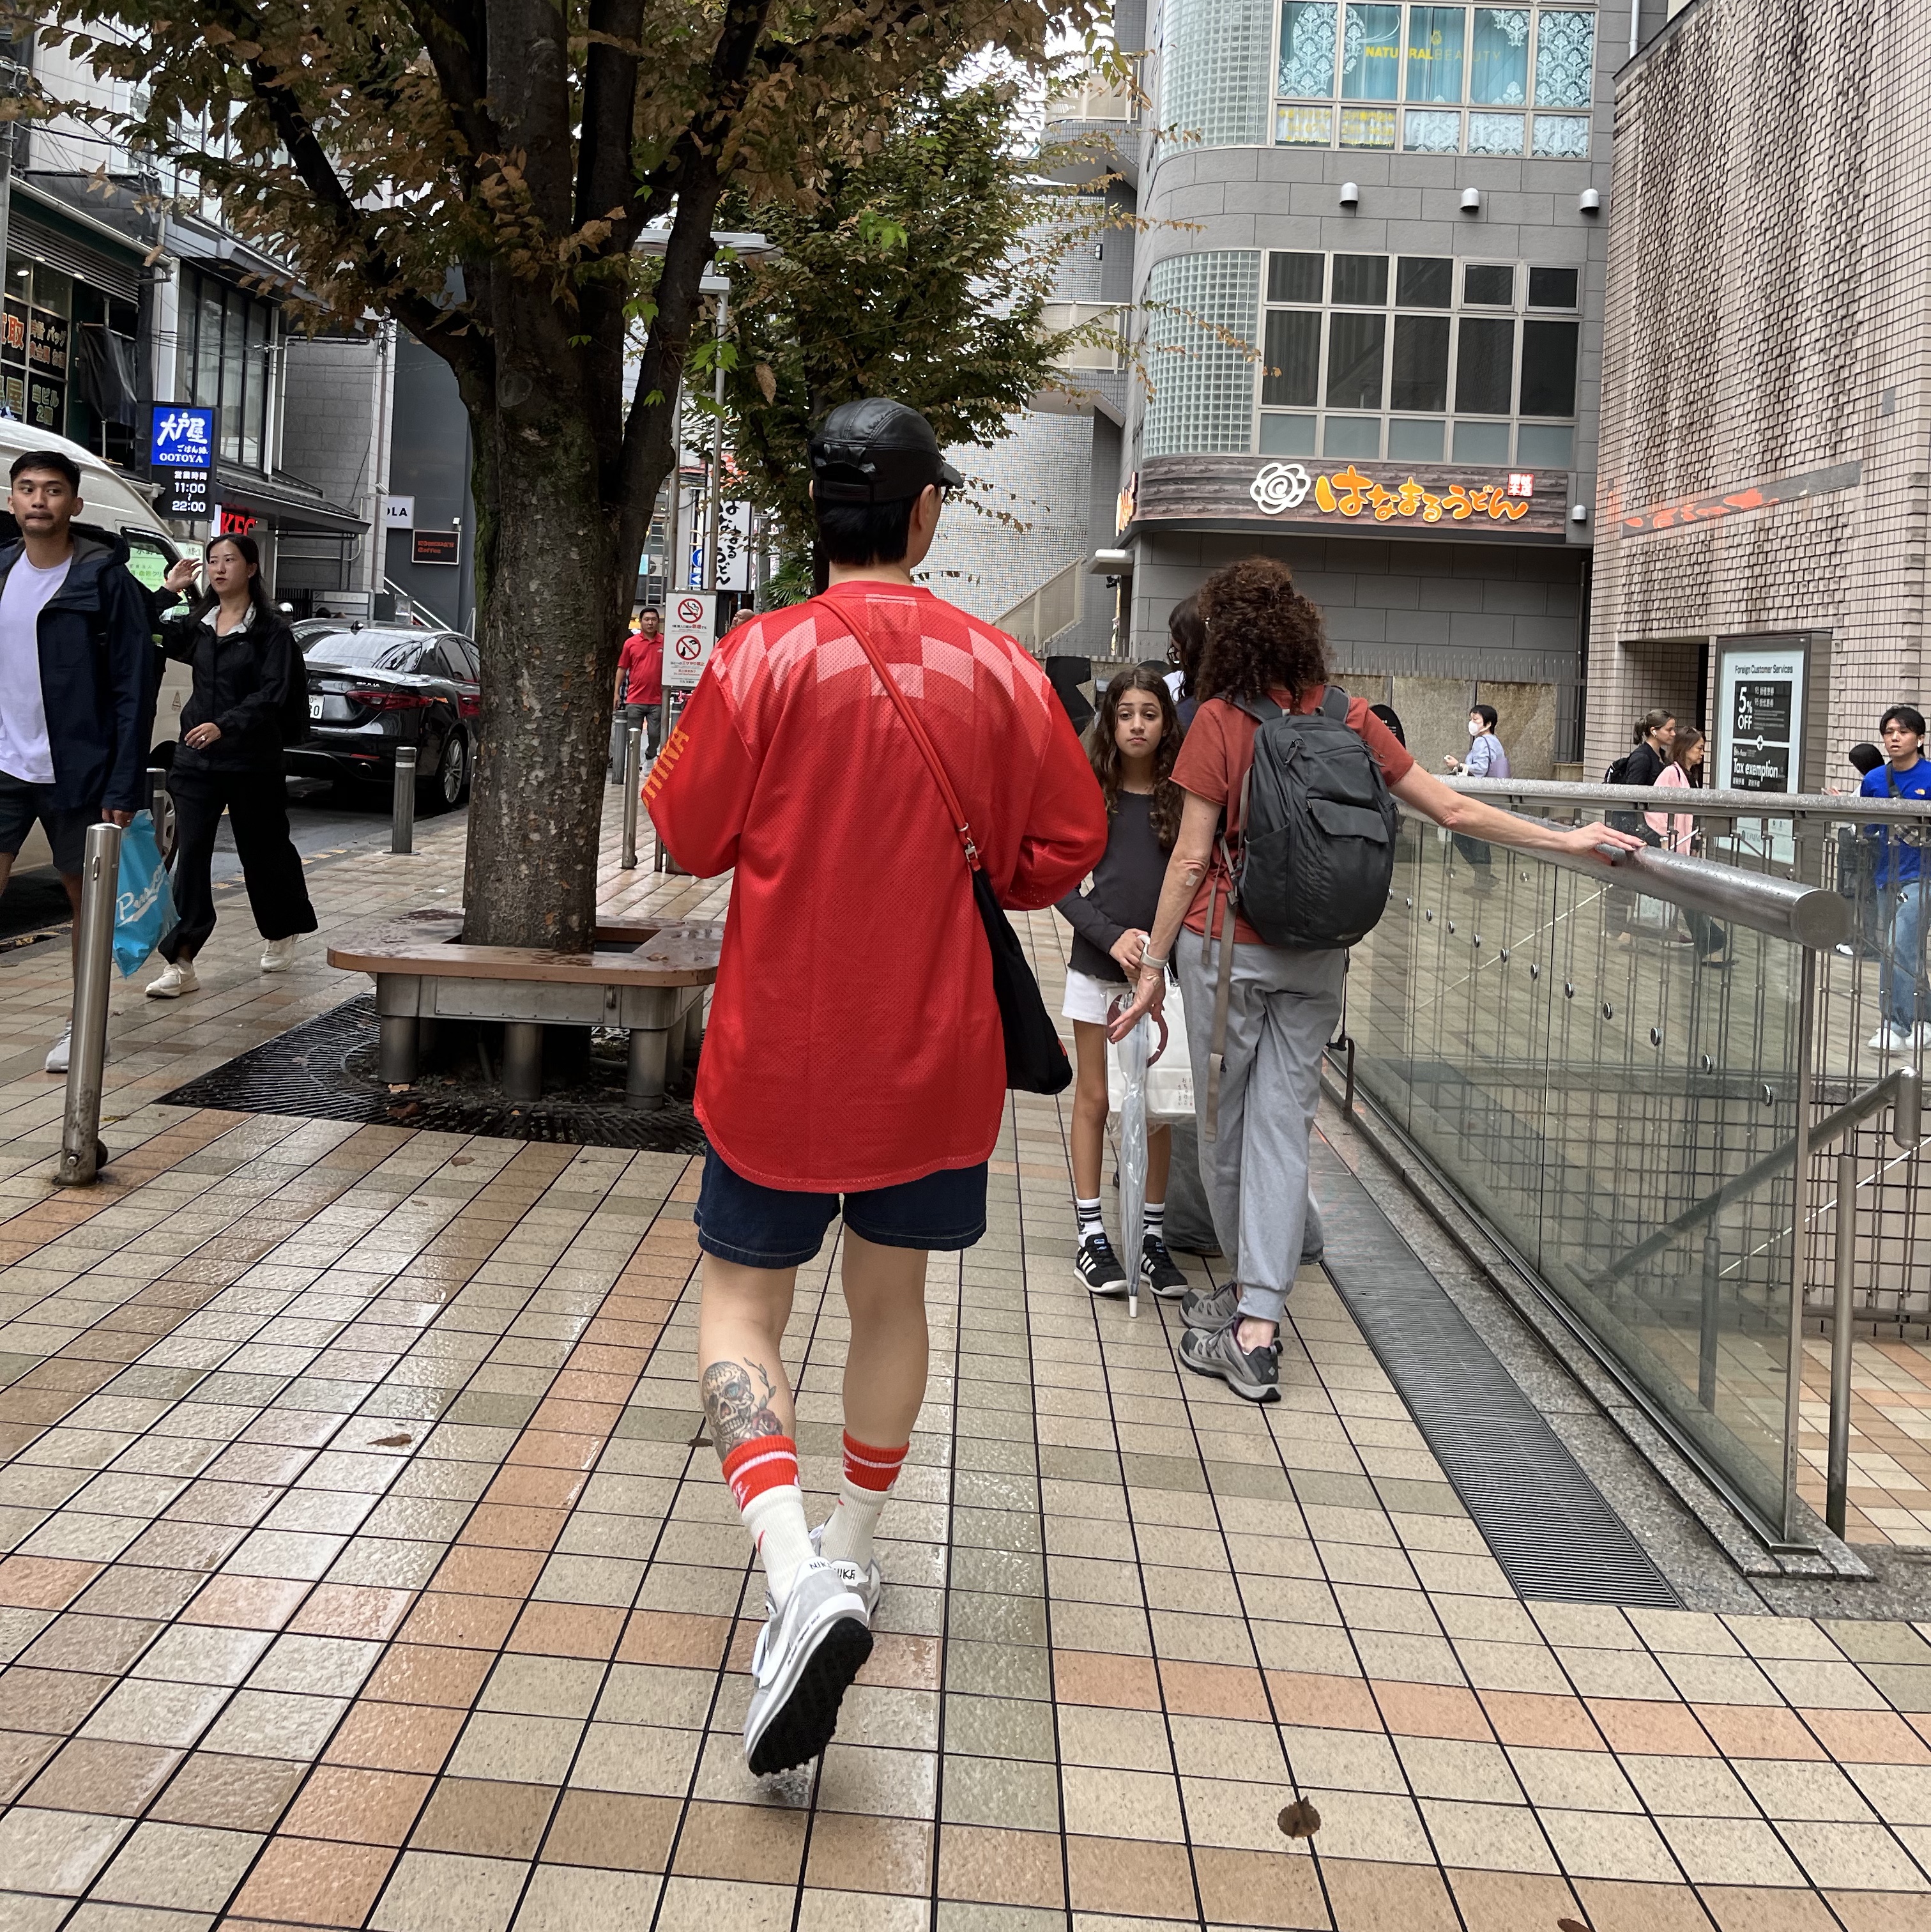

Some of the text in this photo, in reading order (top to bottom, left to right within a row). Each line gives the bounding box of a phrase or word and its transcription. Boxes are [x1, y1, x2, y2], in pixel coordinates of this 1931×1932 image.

[1365, 45, 1433, 60] NATURAL
[159, 452, 204, 464] OOTOYA
[174, 482, 206, 494] 11:00
[1314, 464, 1529, 523] はなまるうどん
[172, 500, 206, 512] 22:00
[221, 512, 256, 536] KFC
[1737, 714, 1753, 730] OFF
[1734, 758, 1744, 774] Tax
[1745, 760, 1778, 782] exemption
